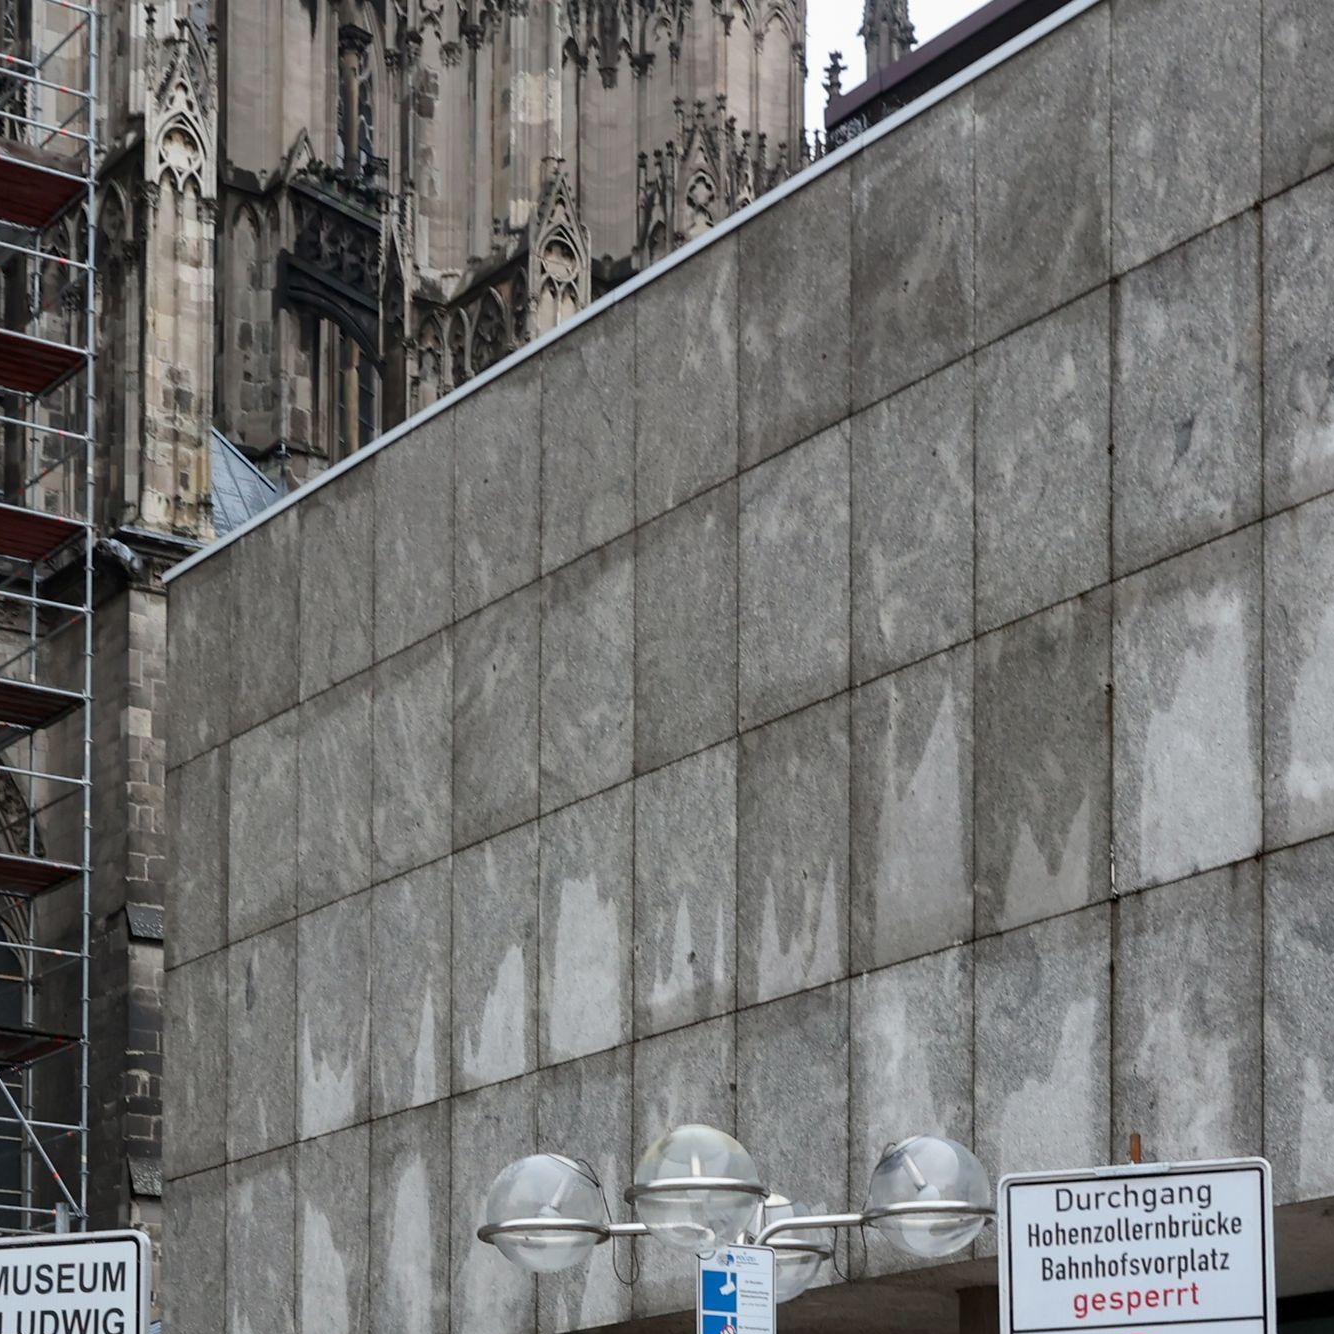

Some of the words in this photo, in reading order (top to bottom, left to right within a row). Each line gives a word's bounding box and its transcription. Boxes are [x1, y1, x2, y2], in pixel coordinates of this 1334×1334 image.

[1055, 1184, 1212, 1213] Durchgang
[1027, 1211, 1243, 1248] Hohenzollernbrücke
[1041, 1249, 1230, 1281] Bahnhofsvorplatz
[1073, 1282, 1200, 1319] gesperrt
